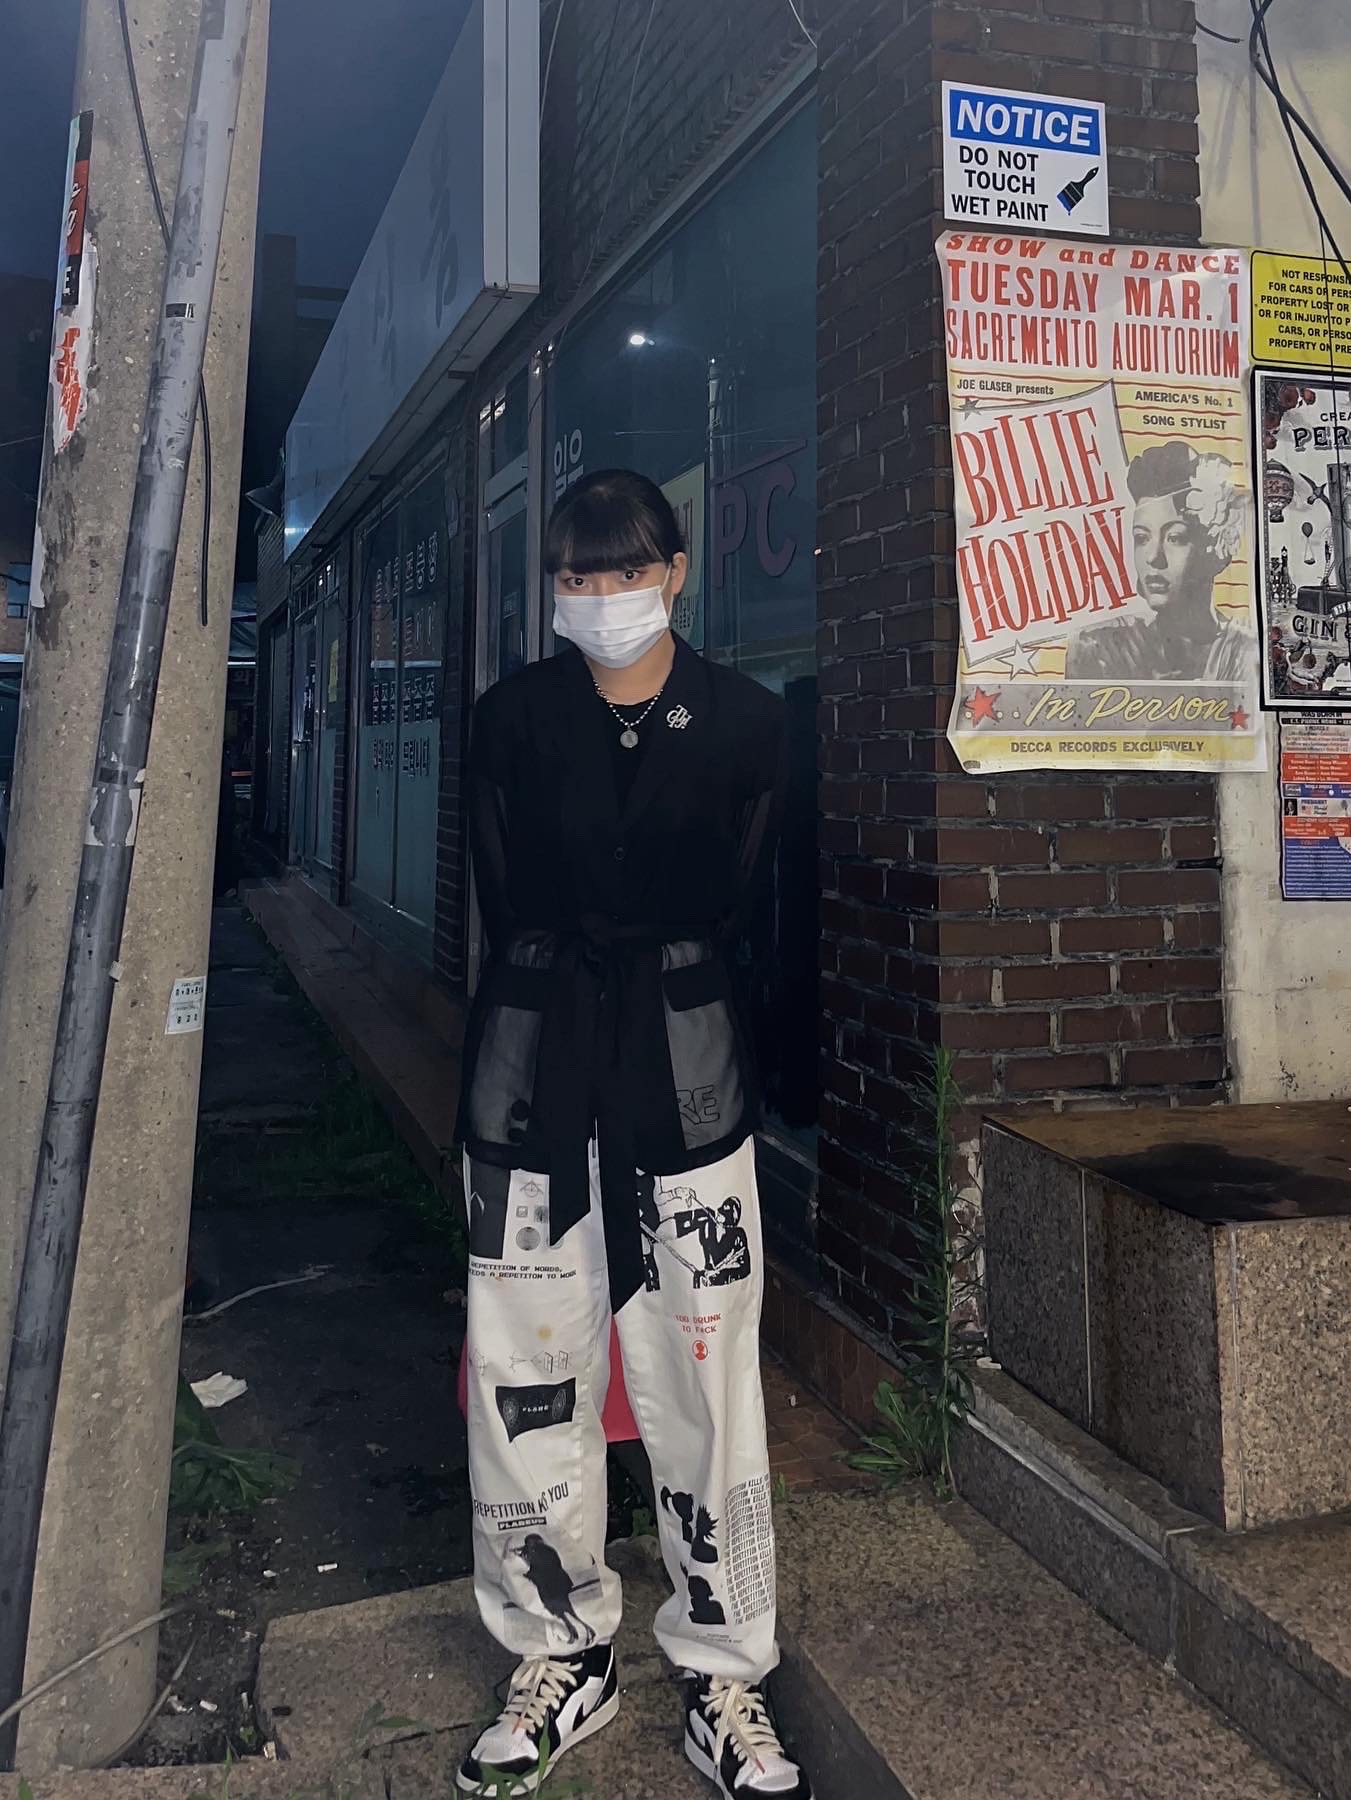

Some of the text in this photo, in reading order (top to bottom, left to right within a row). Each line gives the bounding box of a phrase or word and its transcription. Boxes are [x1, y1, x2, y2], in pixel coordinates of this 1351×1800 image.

[957, 99, 1093, 147] NOTICE
[959, 145, 1039, 172] DO NOT
[964, 169, 1035, 195] TOUCH
[951, 194, 1048, 222] WET PAINT
[946, 233, 1240, 275] SHOW and DANCE
[1282, 269, 1300, 280] NOT
[946, 258, 1099, 313] TUESDAY
[1124, 276, 1213, 321] MAR.
[1268, 281, 1286, 292] FOR
[1289, 284, 1313, 295] CARS
[1261, 295, 1349, 312] PROPERTY LOST OR
[1259, 309, 1271, 318] OR
[1274, 310, 1292, 320] FOR
[1295, 312, 1328, 324] INJURY
[1331, 316, 1342, 325] TO
[946, 308, 1240, 379] SACREMENTO AUDITORIUM
[1269, 338, 1316, 350] PROPERTY
[1278, 325, 1305, 337] CARS,
[1308, 328, 1320, 337] OR
[957, 379, 1054, 395] JOE GLASER presents
[1135, 391, 1199, 405] AMERICA'S
[1227, 398, 1233, 407] 1
[1143, 415, 1227, 430] SONG STYLIST
[954, 407, 1115, 529] BILLIE
[710, 461, 798, 589] PC
[957, 506, 1137, 643] HOLIDAY
[1292, 615, 1337, 641] GIN
[1024, 686, 1231, 728] In Person
[1011, 741, 1204, 753] DECCA RECORDS EXCLUSIVELY
[474, 1499, 536, 1518] REPETITION
[548, 1481, 569, 1503] YOU
